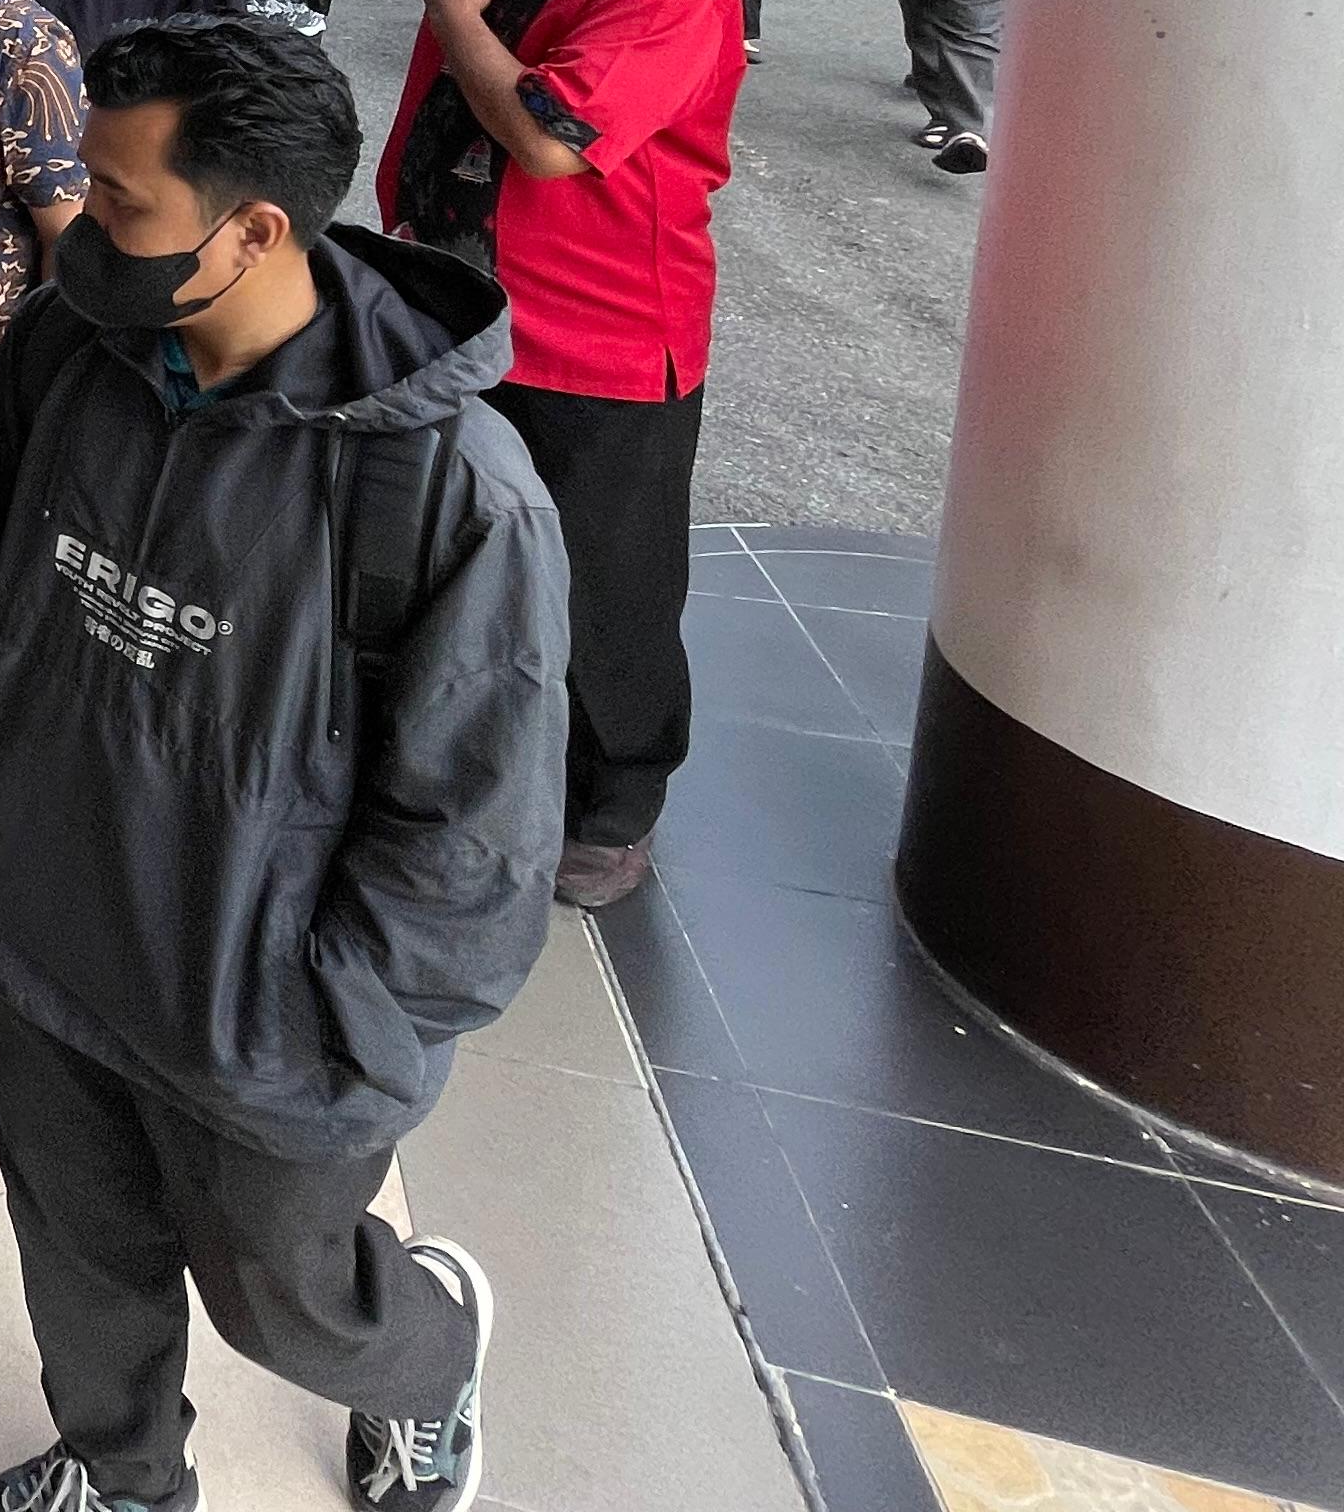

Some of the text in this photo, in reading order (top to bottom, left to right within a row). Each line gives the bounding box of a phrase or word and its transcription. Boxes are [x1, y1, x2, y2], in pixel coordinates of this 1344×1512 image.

[54, 561, 94, 593] YOUTH
[142, 619, 213, 656] PROJECT
[55, 533, 217, 640] ERIGO
